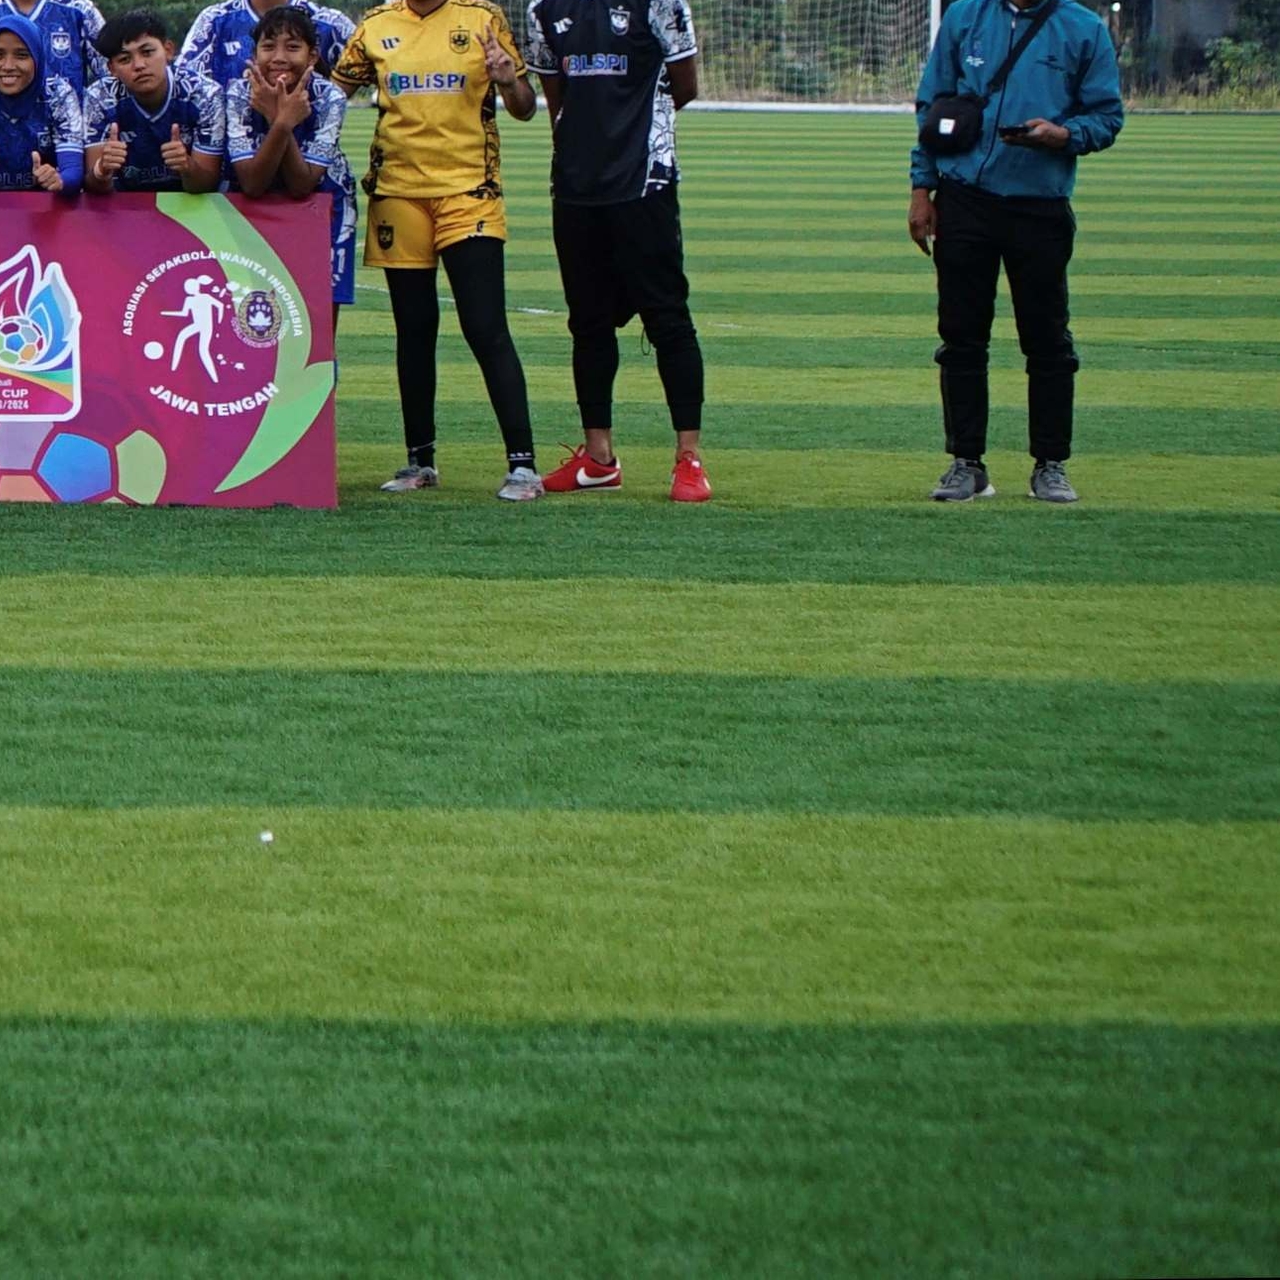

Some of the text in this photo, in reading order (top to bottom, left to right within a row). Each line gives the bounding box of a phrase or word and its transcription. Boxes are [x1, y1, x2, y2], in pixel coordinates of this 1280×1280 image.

[145, 250, 217, 283] SEPAKBOLA
[219, 251, 268, 277] WANITA
[1, 388, 29, 398] CUP
[149, 381, 280, 417] JAWA TENGAH
